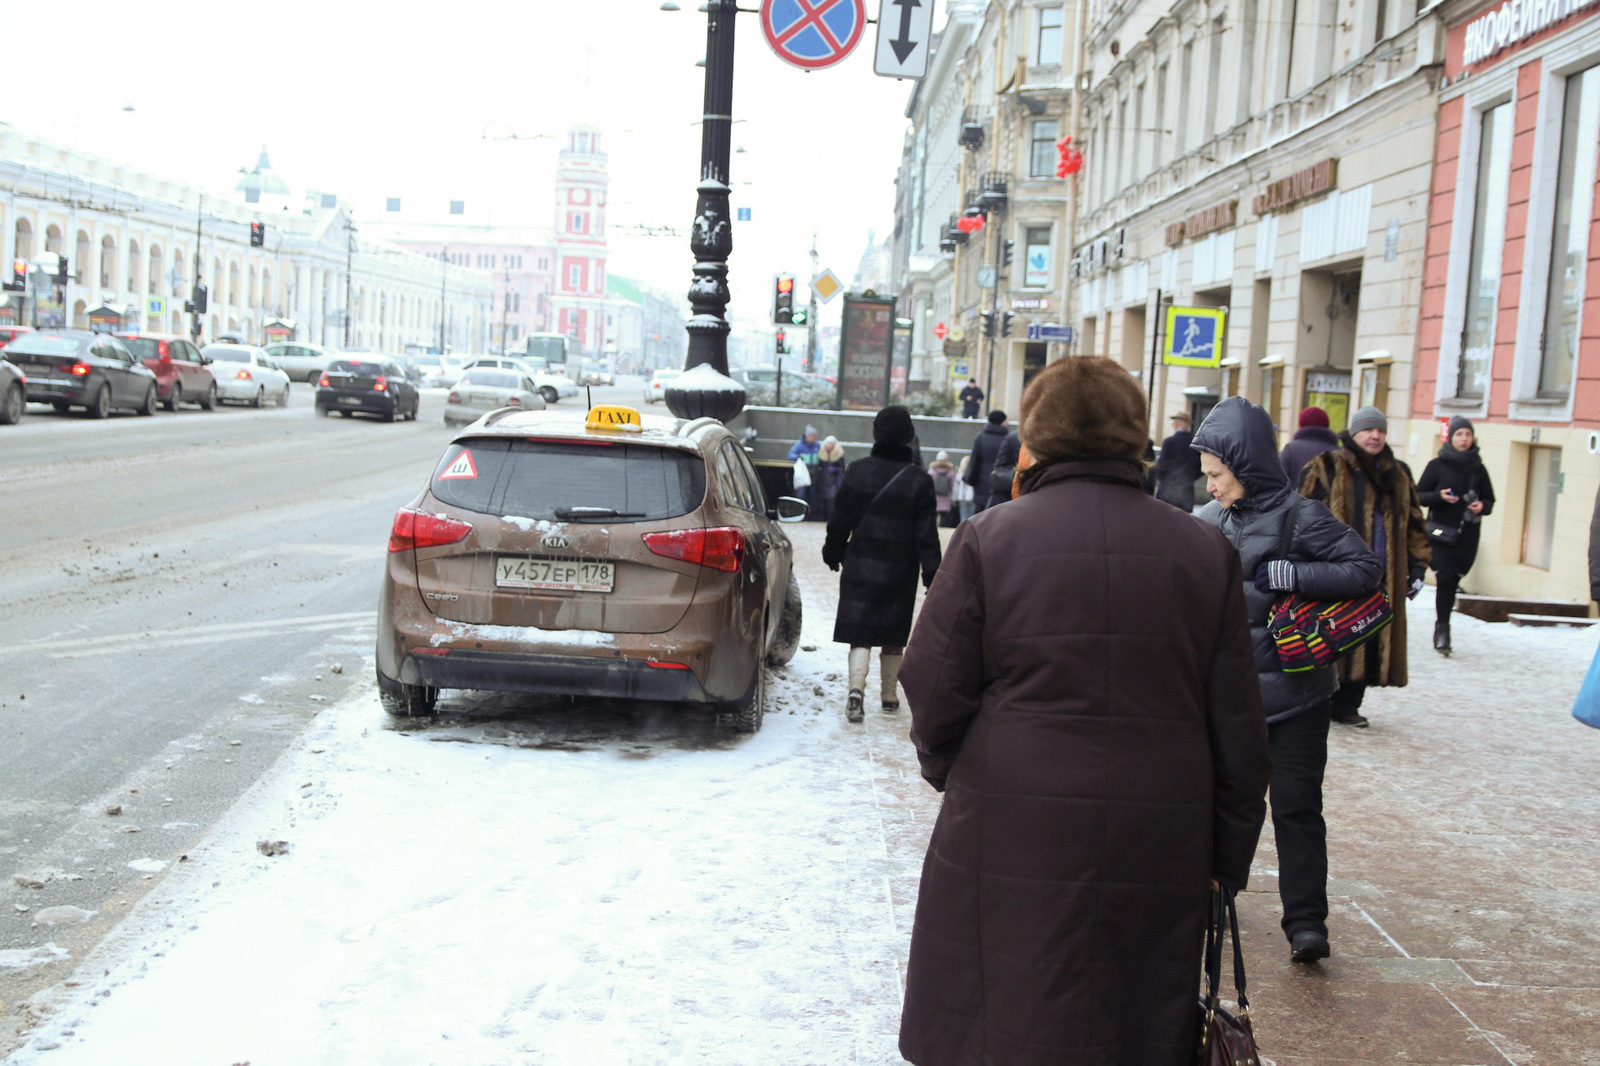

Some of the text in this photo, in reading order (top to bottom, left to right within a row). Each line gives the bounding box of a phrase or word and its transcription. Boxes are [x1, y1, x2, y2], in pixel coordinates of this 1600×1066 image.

[595, 410, 631, 424] TAXI
[452, 463, 467, 473] Ш
[545, 537, 566, 548] KIA
[581, 565, 609, 579] 178
